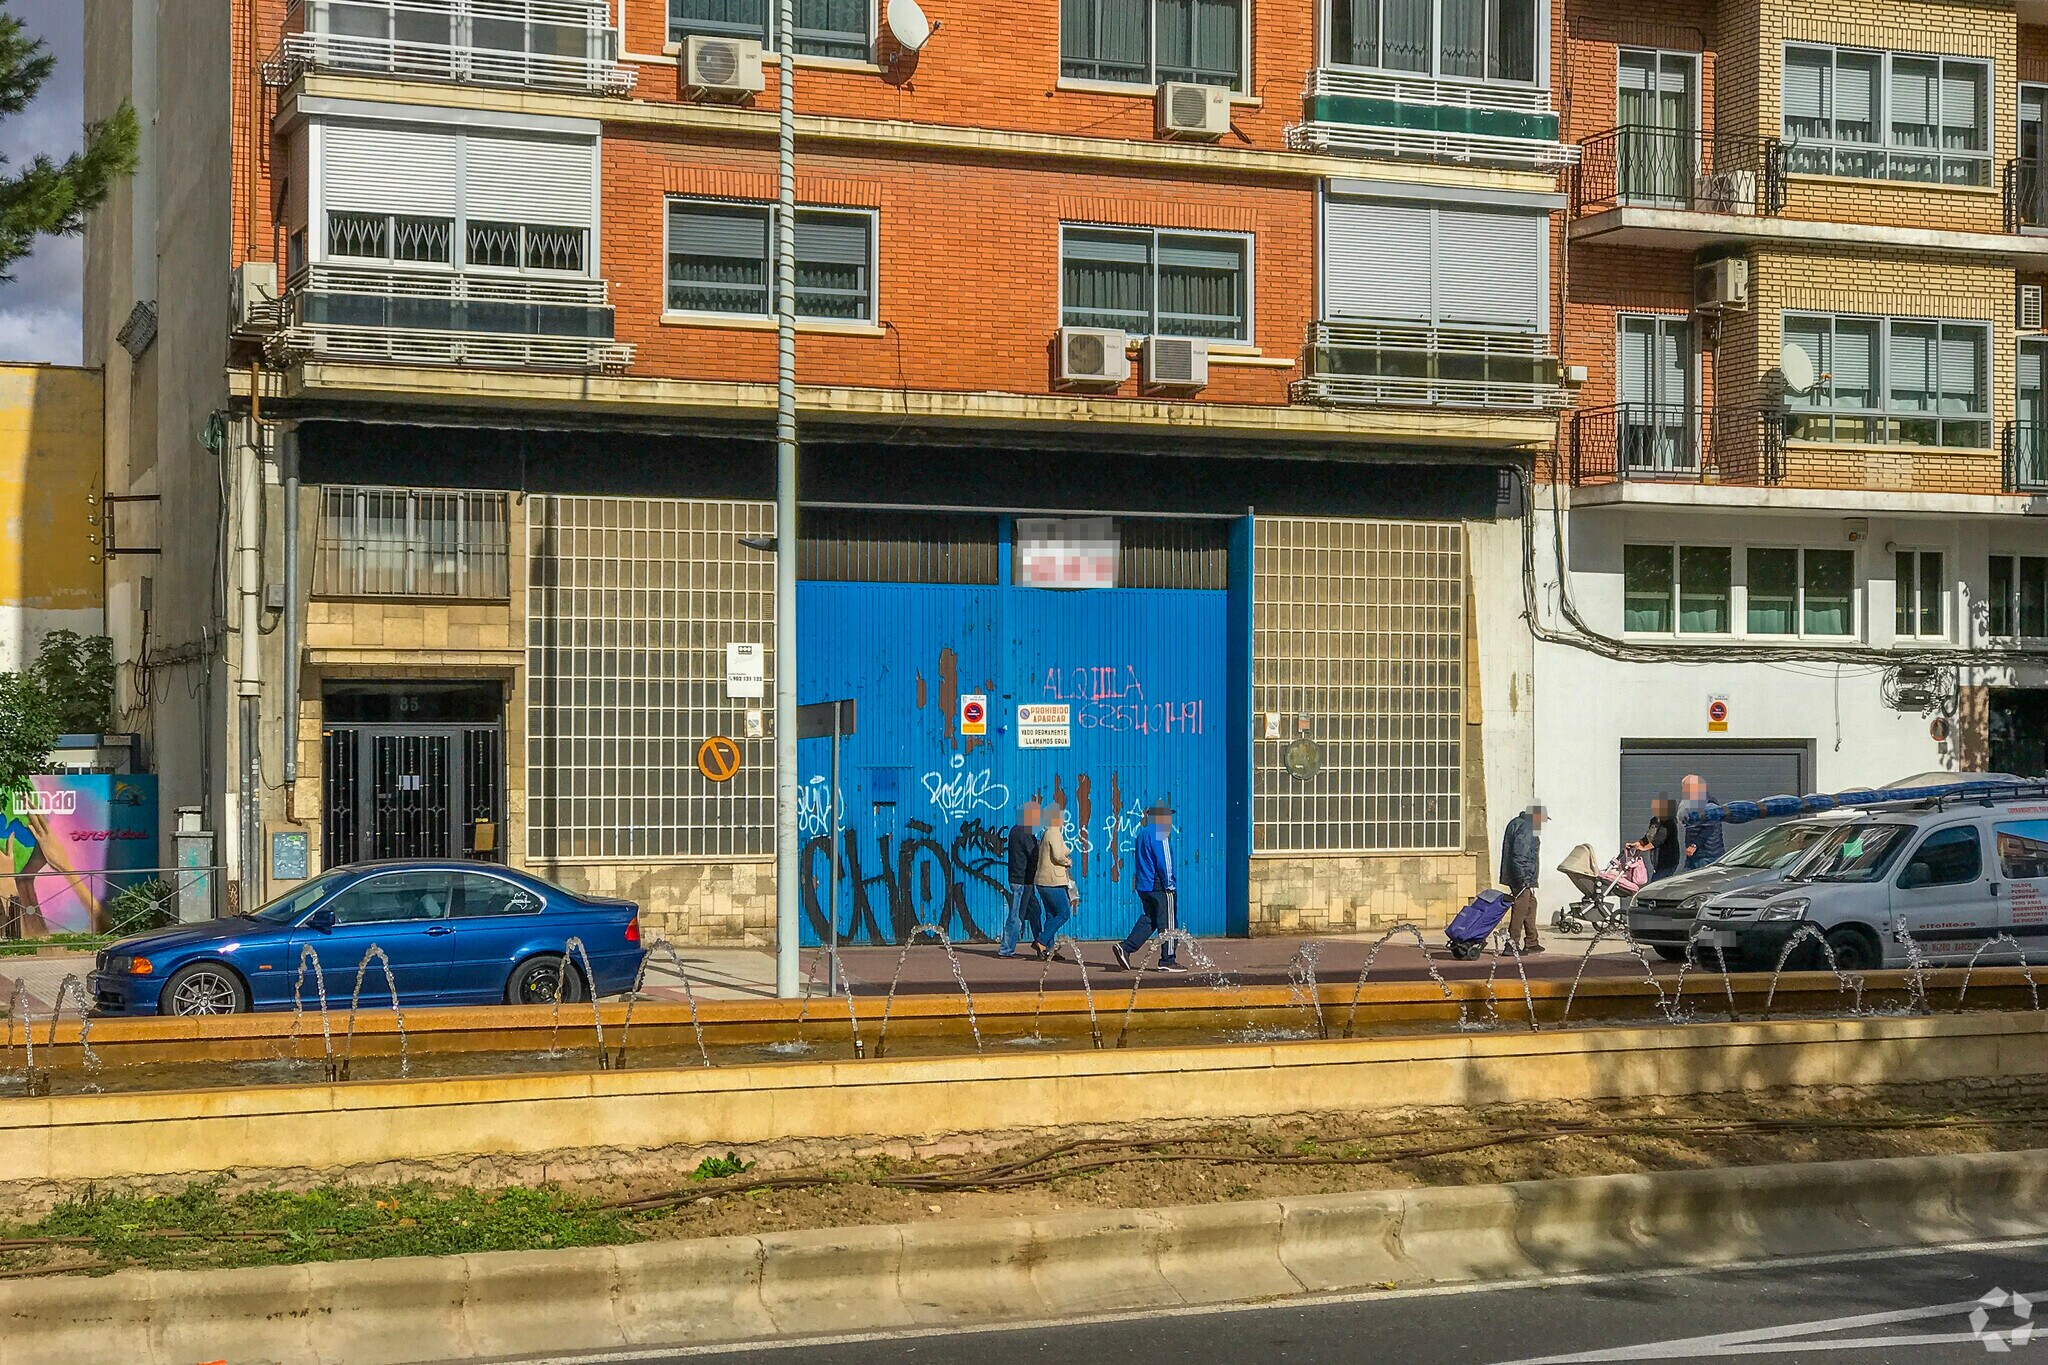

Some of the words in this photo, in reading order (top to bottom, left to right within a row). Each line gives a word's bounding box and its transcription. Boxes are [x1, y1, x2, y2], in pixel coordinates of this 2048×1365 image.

[400, 696, 419, 711] 85
[1030, 706, 1069, 715] PROHIBIDO
[1032, 715, 1066, 723] APARCAR
